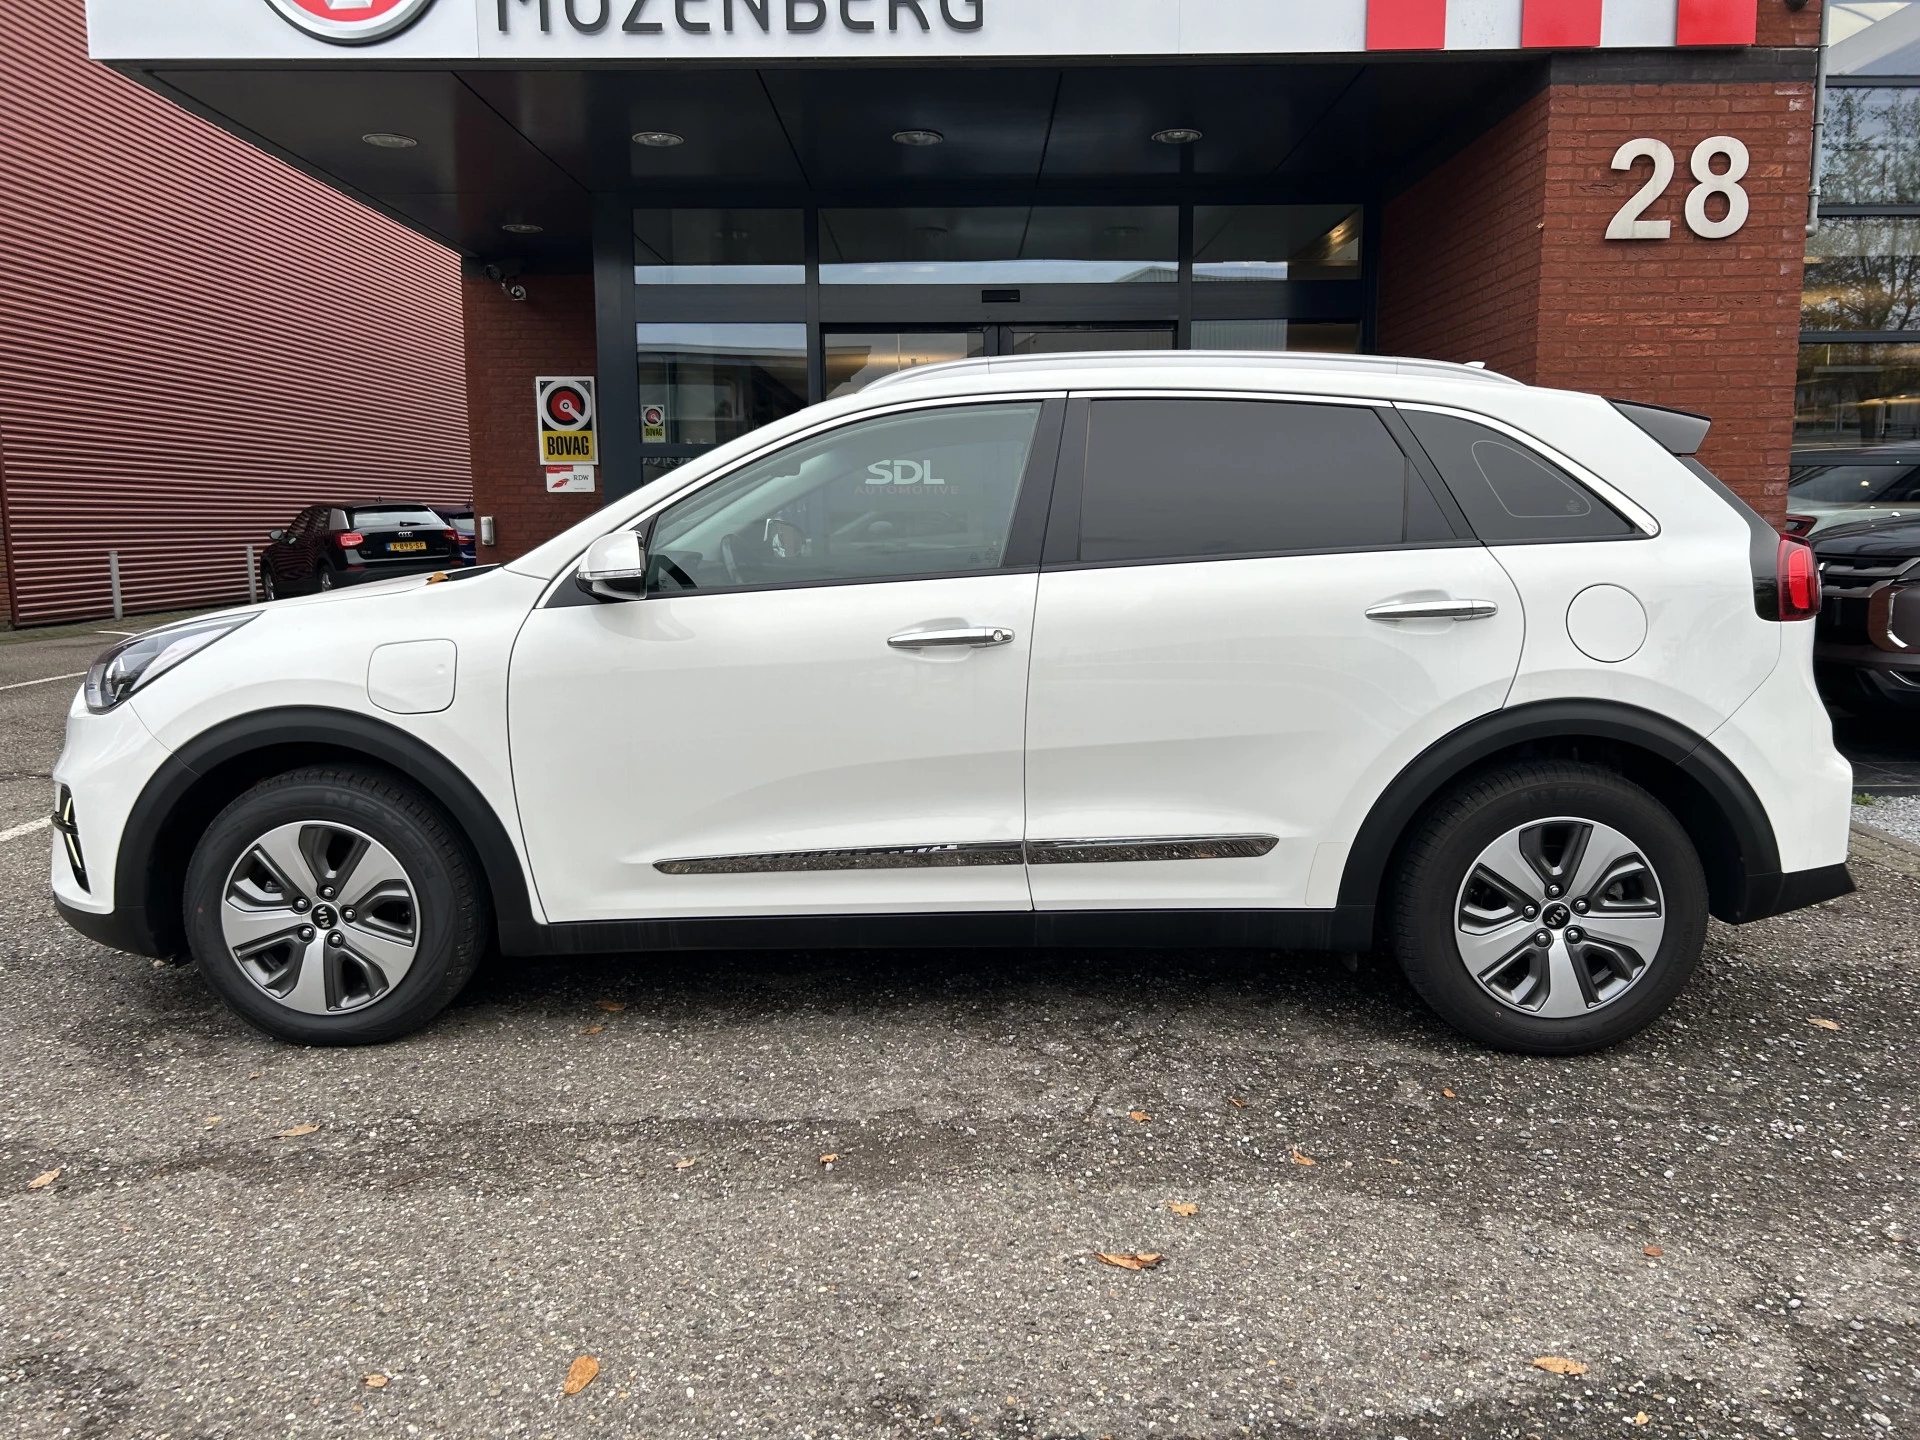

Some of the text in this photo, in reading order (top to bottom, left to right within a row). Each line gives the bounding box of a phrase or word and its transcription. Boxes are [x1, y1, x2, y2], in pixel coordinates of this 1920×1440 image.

[1605, 135, 1749, 239] 28
[645, 427, 663, 437] BOVAG
[547, 435, 590, 456] BOVAG
[865, 459, 945, 485] SDL
[854, 485, 960, 495] AUTOMOTIVE
[325, 791, 438, 879] NEXEN
[318, 906, 331, 928] KIA
[1547, 906, 1567, 926] KIA
